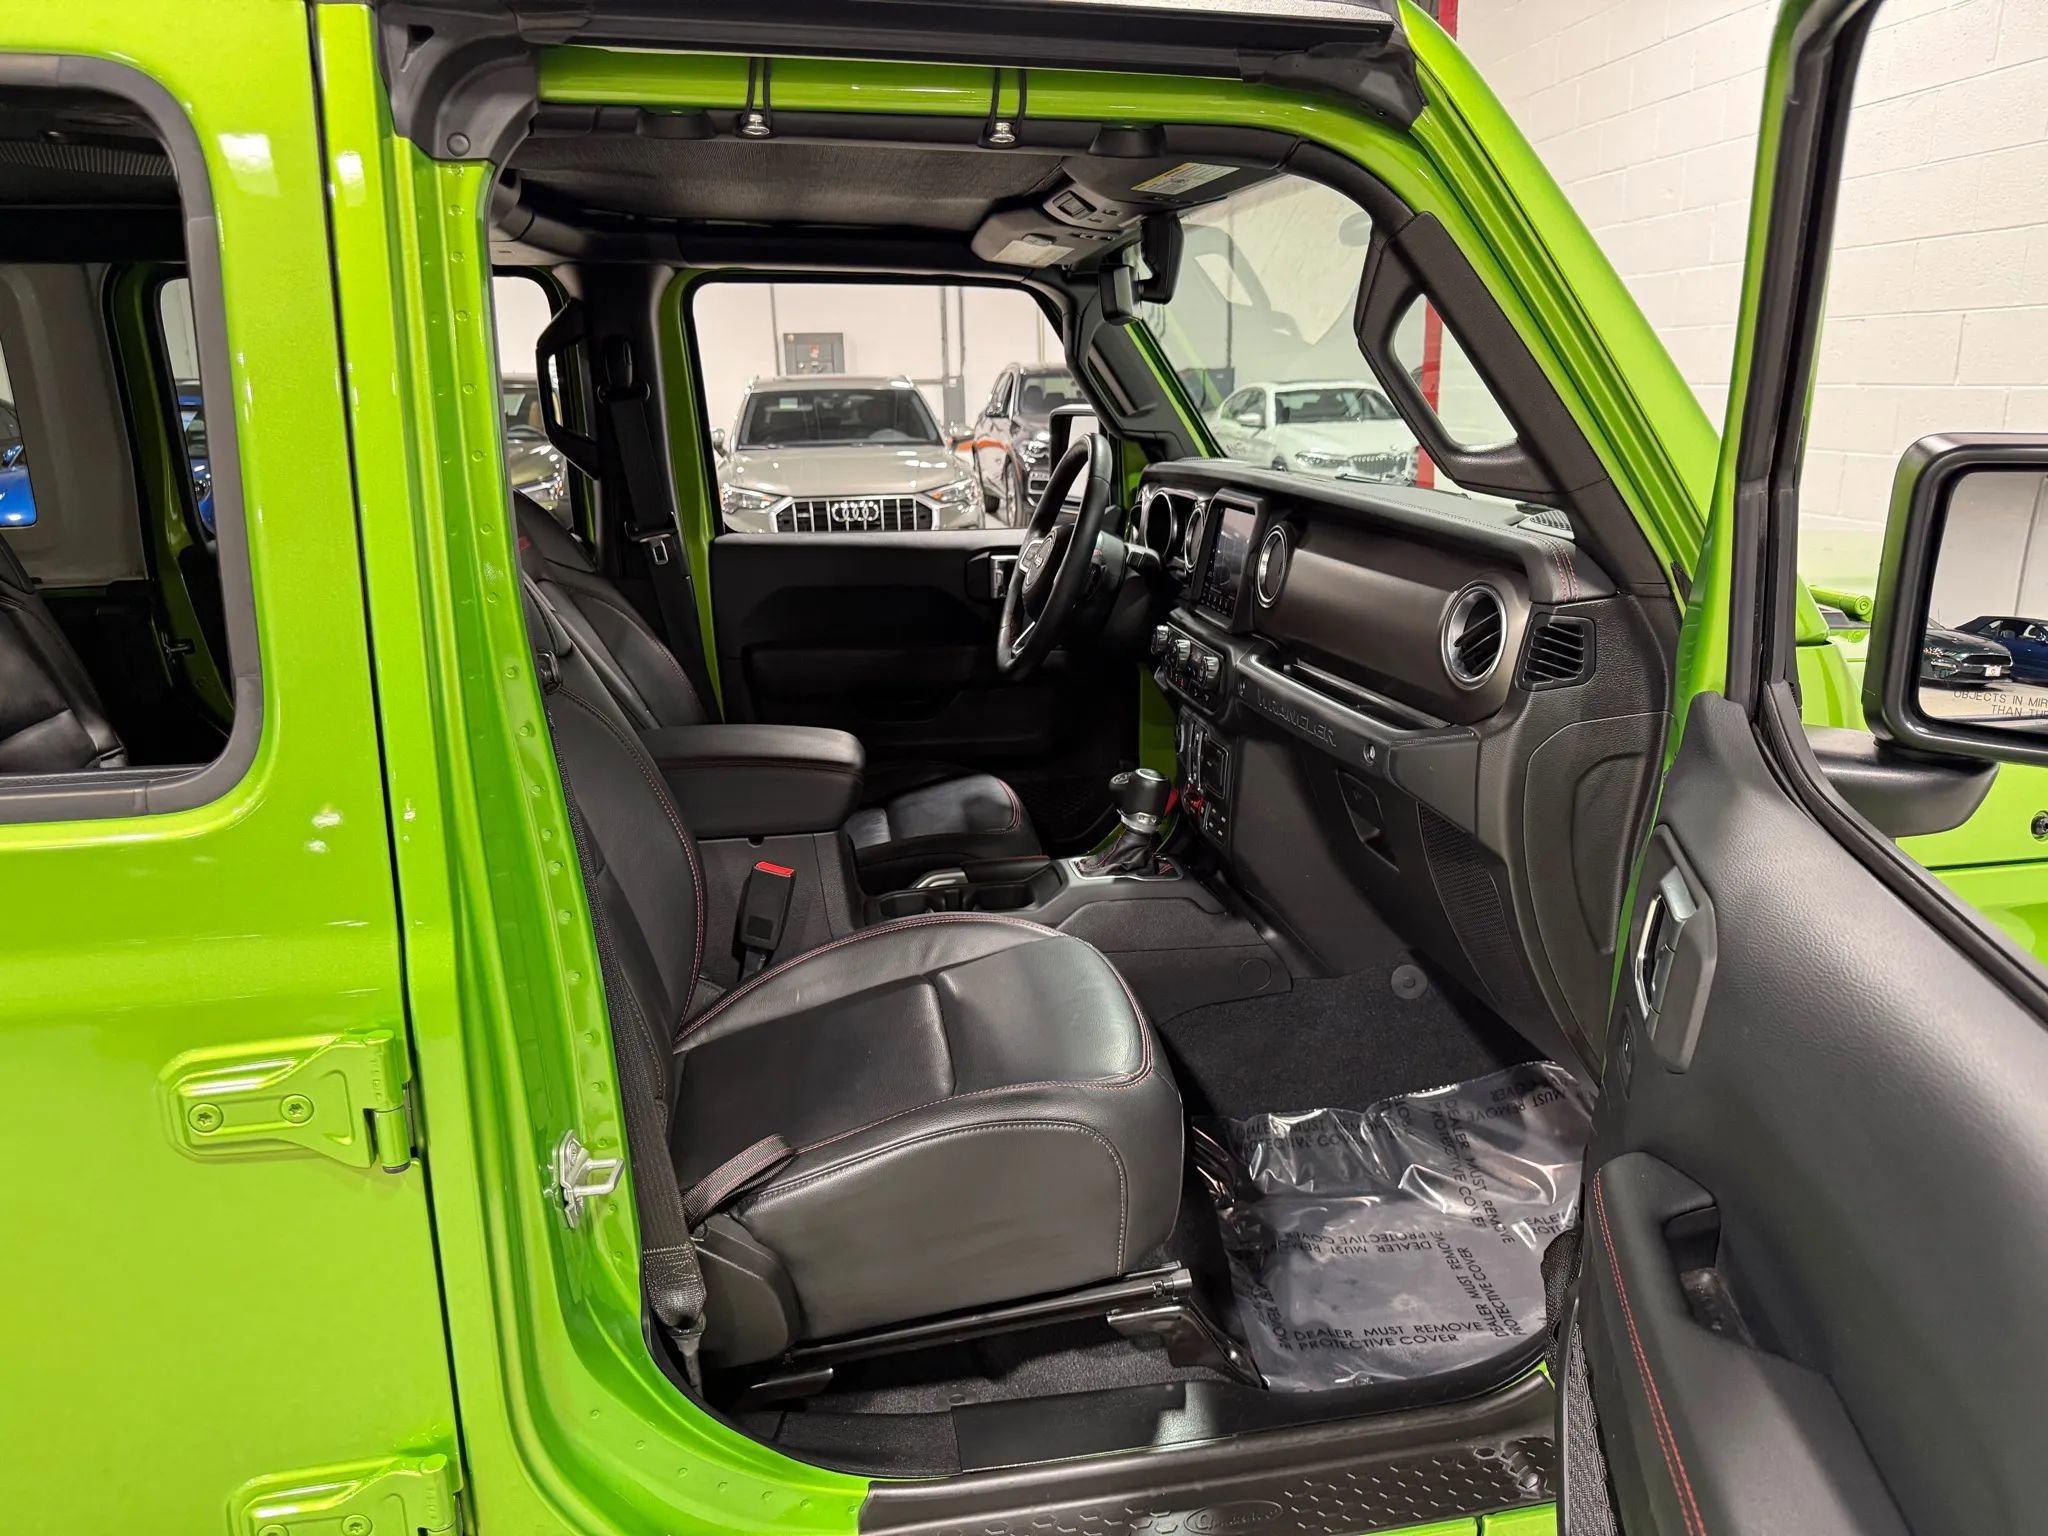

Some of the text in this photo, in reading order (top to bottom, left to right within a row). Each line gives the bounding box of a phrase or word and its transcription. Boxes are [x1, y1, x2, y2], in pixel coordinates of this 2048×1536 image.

[1953, 690, 2007, 704] OBJECTS
[2012, 695, 2023, 706] IN
[1991, 704, 2022, 717] THAN
[1445, 1100, 1515, 1244] DEALER MUST REMOVE
[1330, 1244, 1368, 1255] MUST
[1378, 1240, 1432, 1253] DEALER
[1430, 1231, 1509, 1337] DEALER MUST REMOVE
[1457, 1247, 1527, 1336] PROTECTIVE COVER
[1294, 1321, 1483, 1342] DEALER MUST REMOVE
[1298, 1333, 1460, 1351] PROTECTIVE COVER
